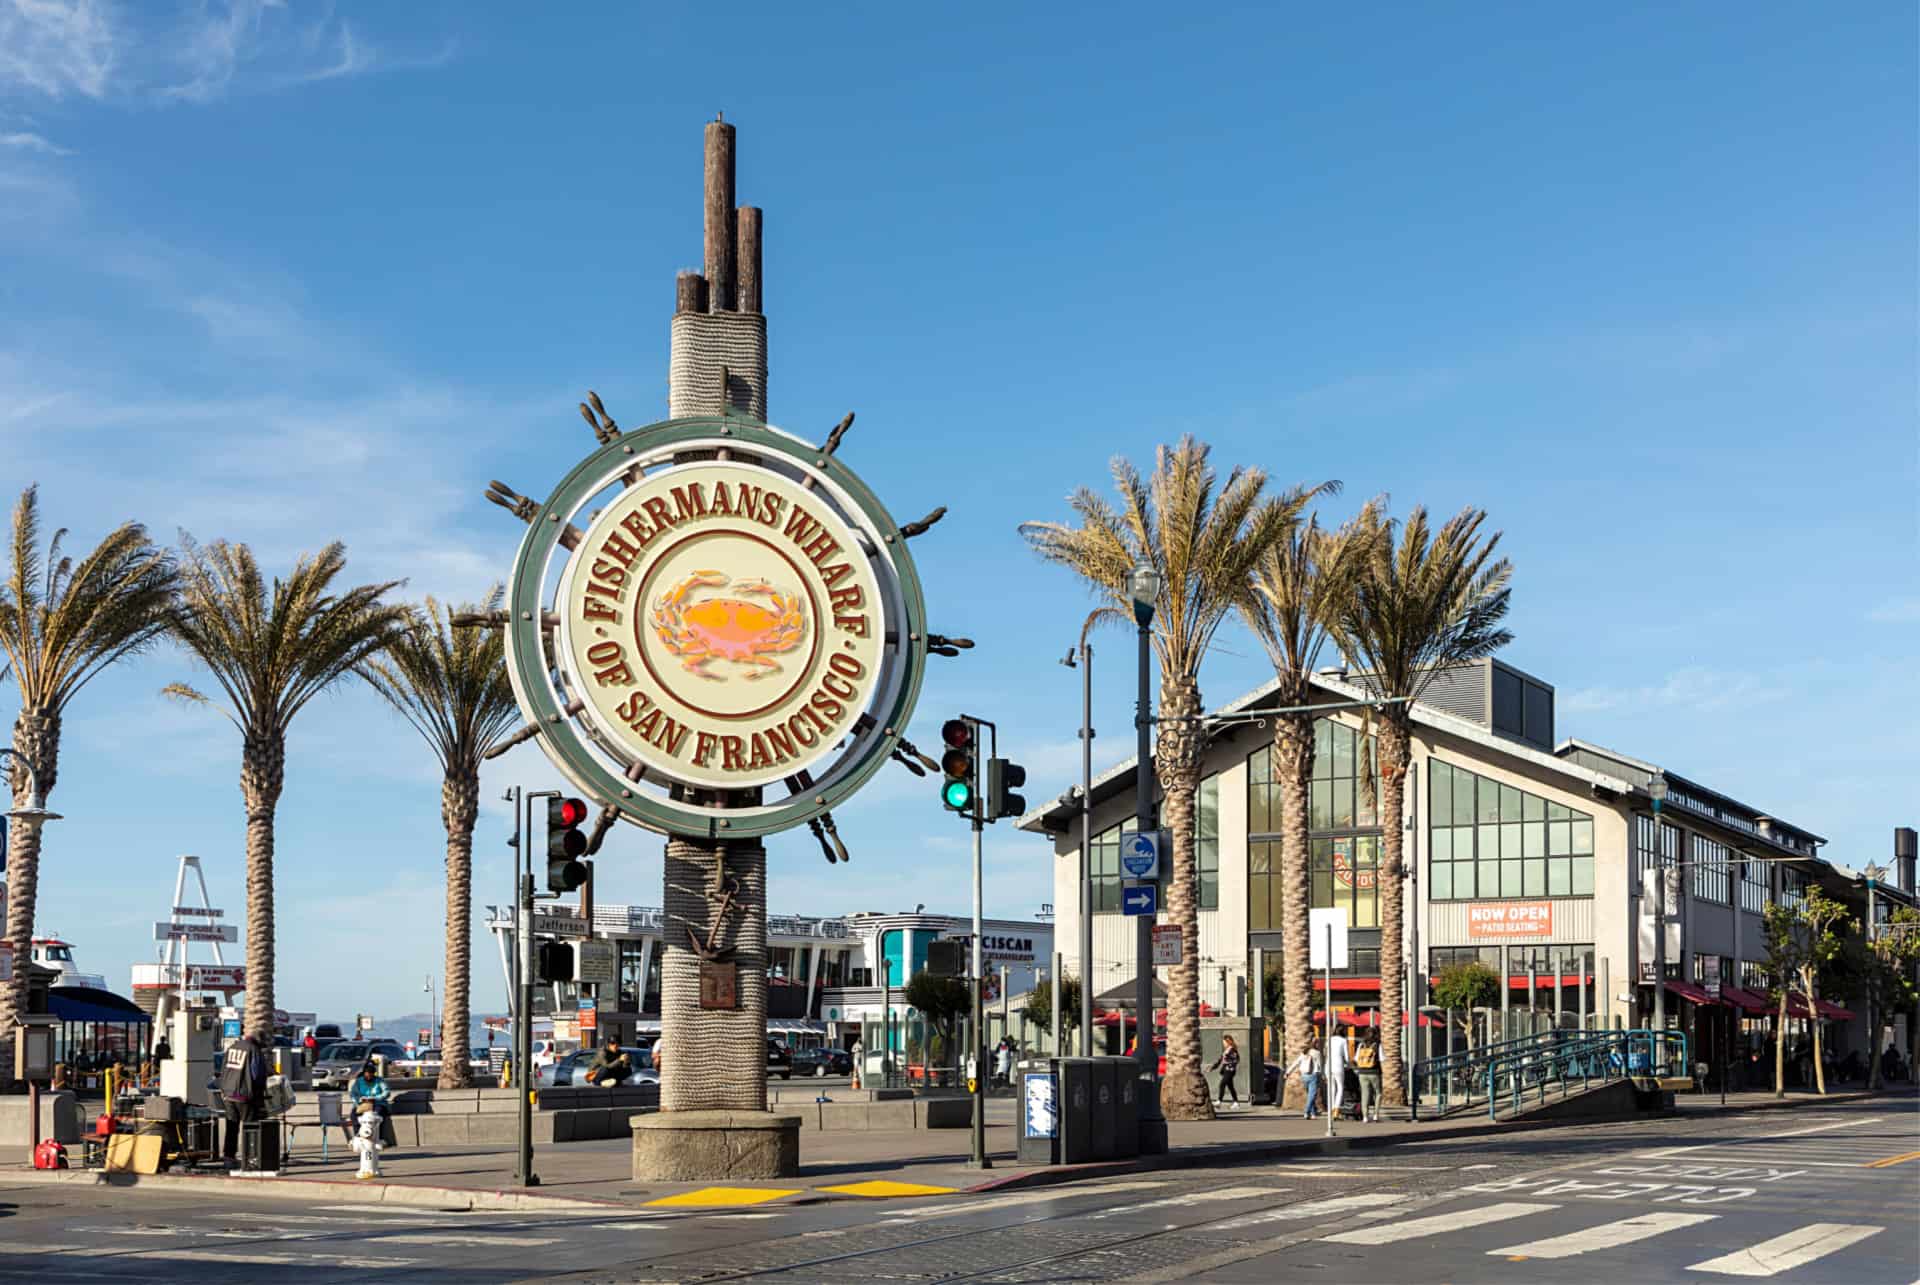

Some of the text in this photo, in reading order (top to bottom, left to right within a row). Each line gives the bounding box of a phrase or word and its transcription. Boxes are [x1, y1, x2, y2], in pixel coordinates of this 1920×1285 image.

[583, 481, 867, 638] FISHERMANS WHARF
[587, 641, 861, 771] OF SAN FRANCISCO
[540, 918, 585, 932] Jefferson
[1472, 907, 1548, 921] NOW OPEN
[1462, 1177, 1757, 1203] CLEAR
